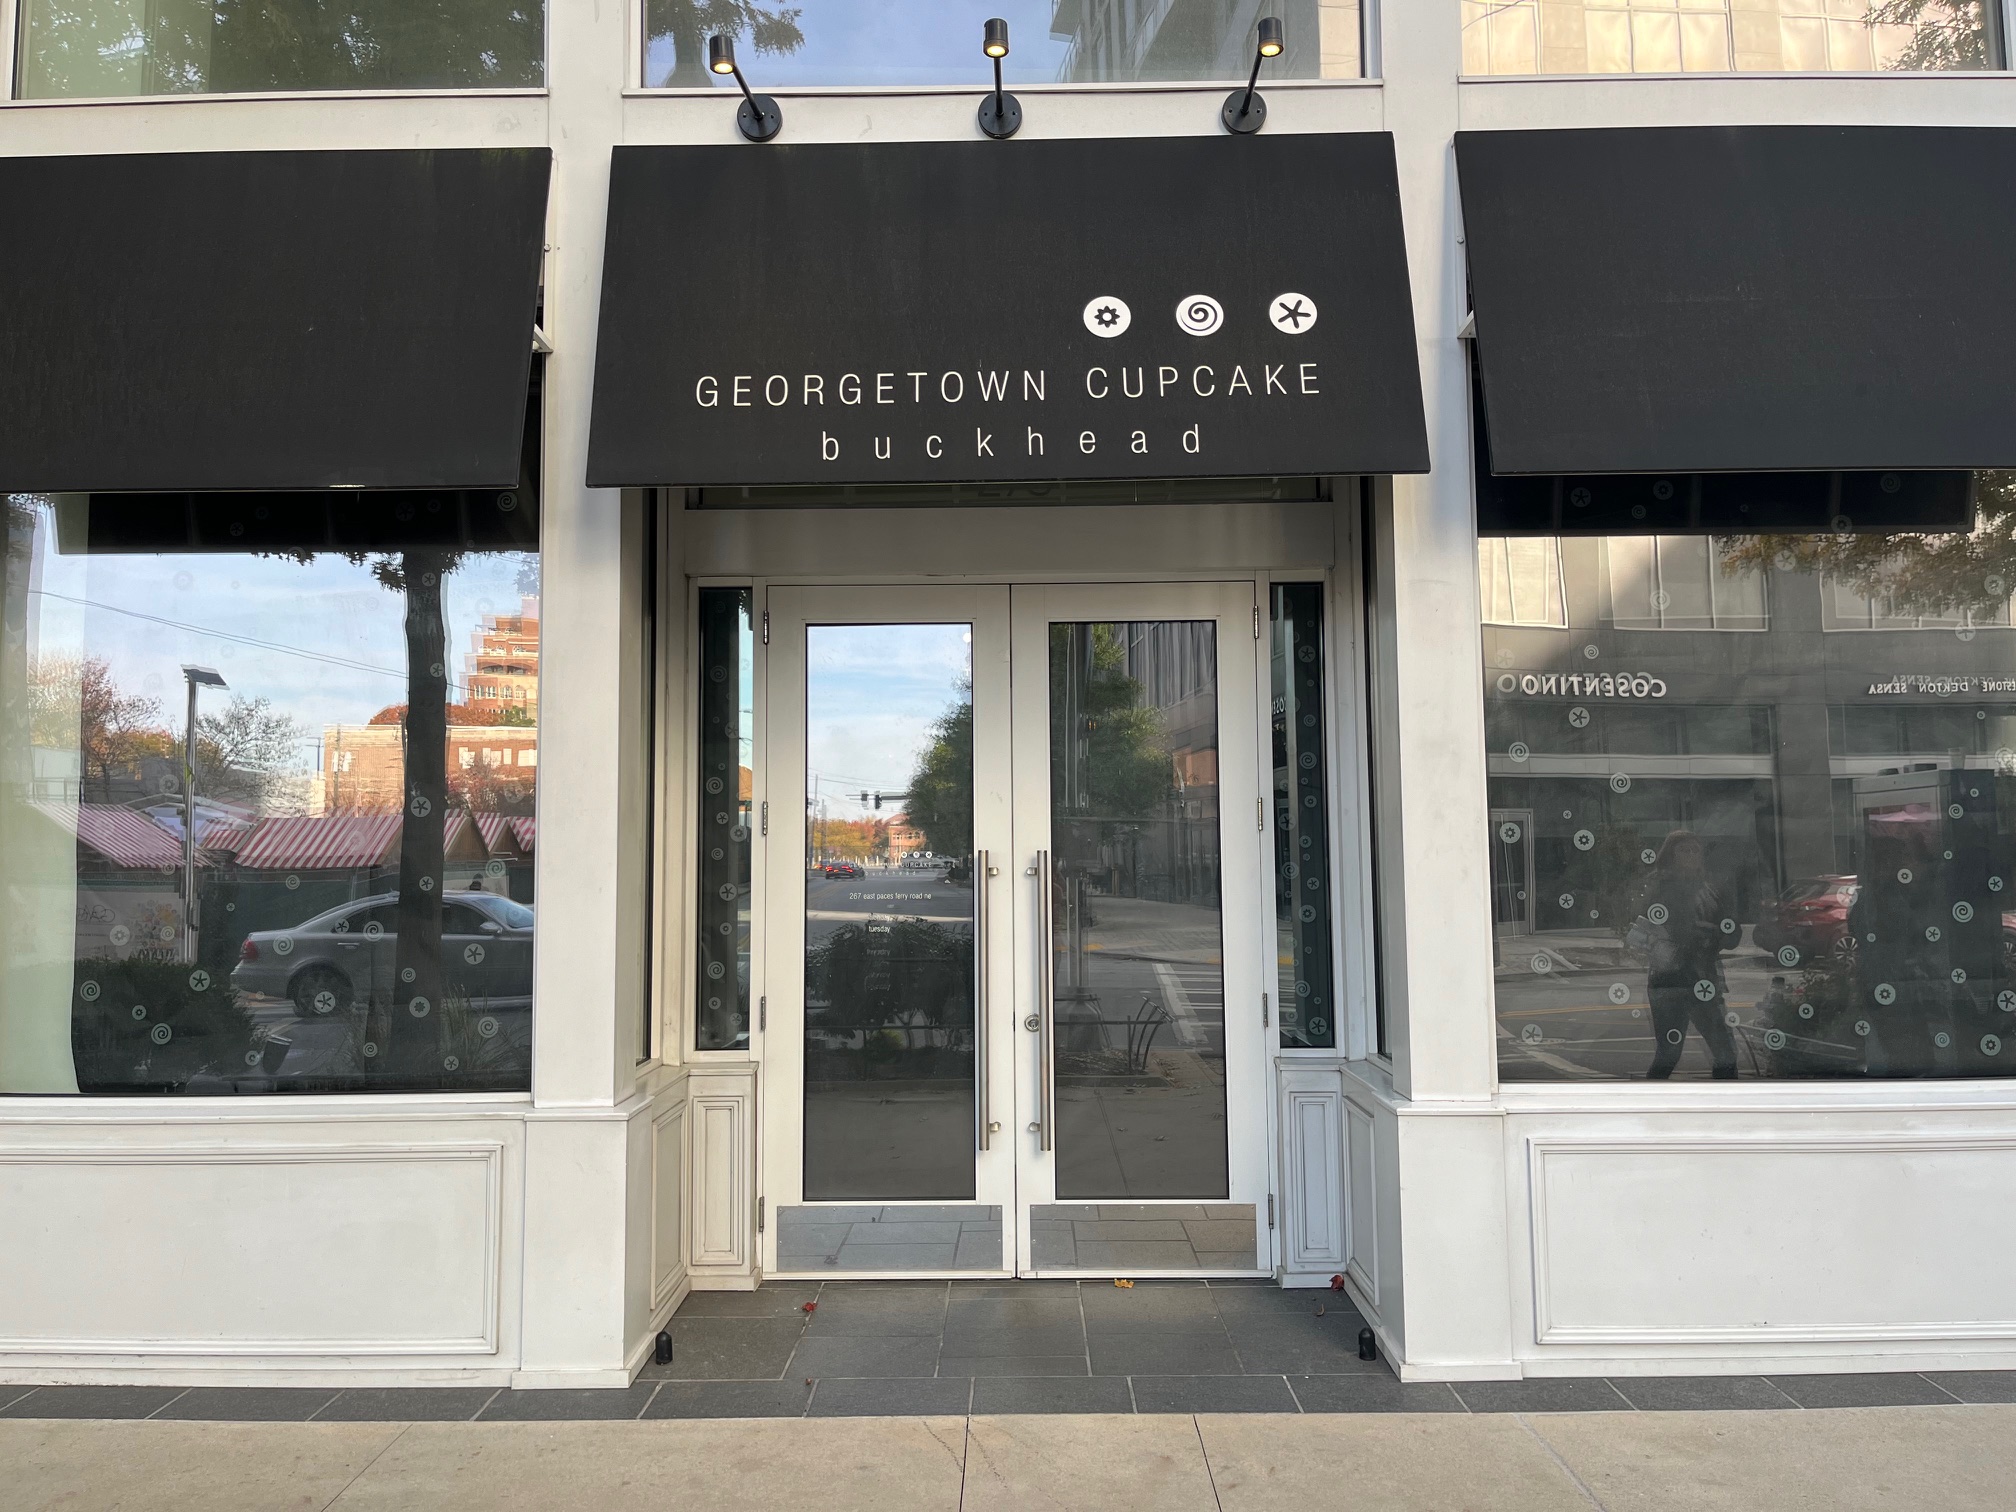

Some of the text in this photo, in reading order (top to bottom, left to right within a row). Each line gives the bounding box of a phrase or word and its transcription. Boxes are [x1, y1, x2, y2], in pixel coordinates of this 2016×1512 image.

[694, 362, 1321, 409] GEORGETOWN CUPCAKE
[821, 422, 1202, 462] buckhead
[849, 892, 862, 900] 267
[876, 893, 894, 901] paces
[895, 892, 909, 901] ferry
[909, 892, 923, 900] road
[868, 925, 891, 934] tuesday
